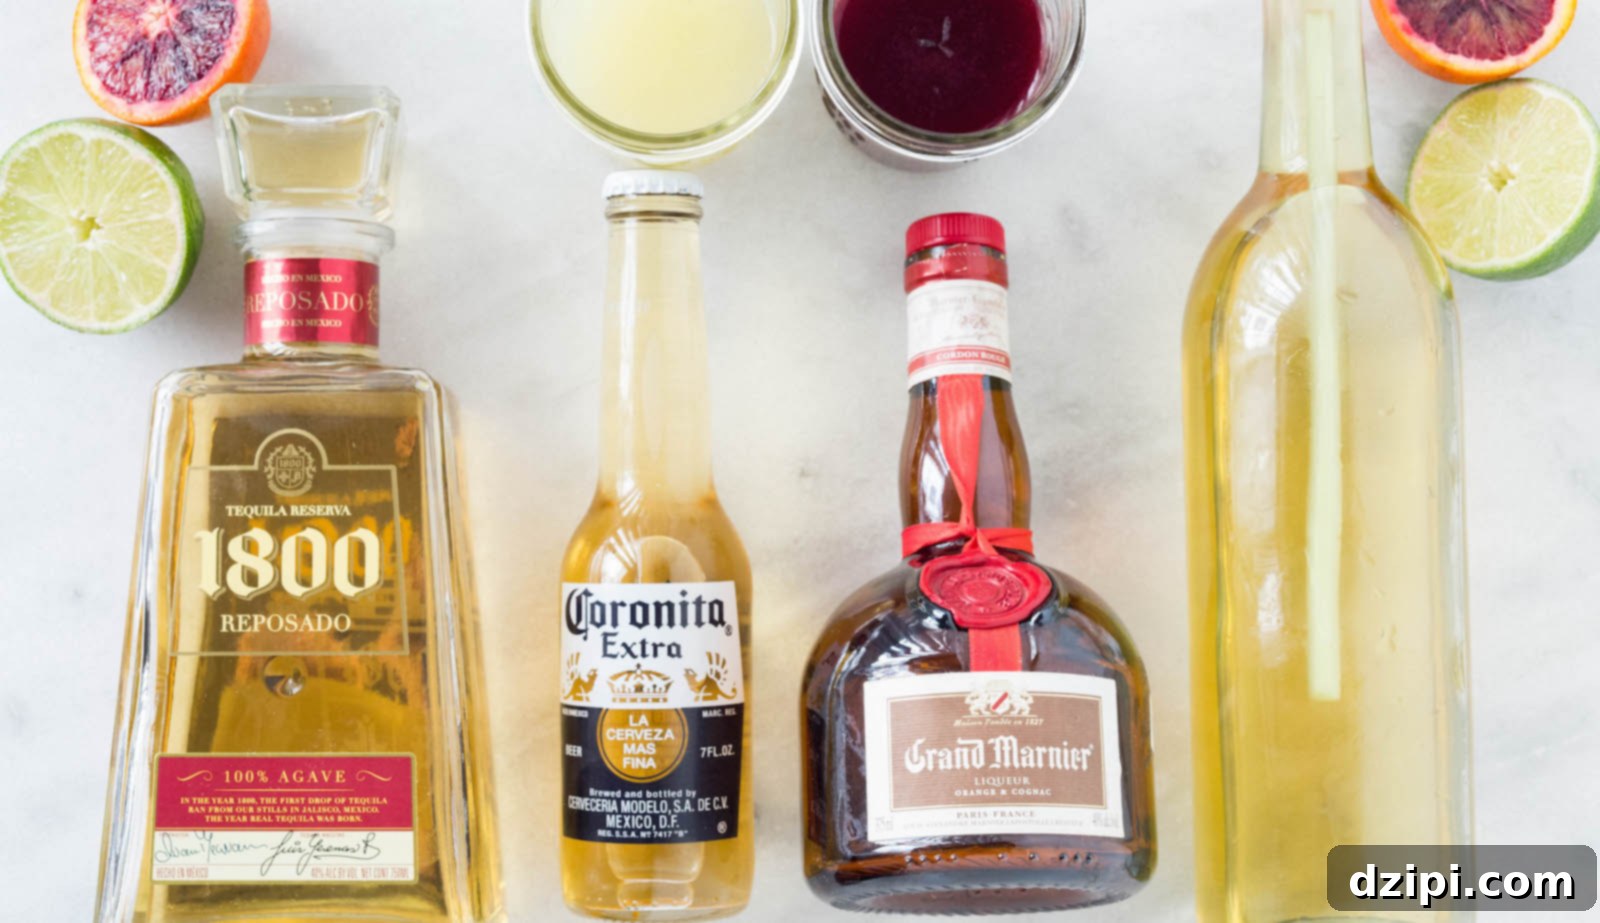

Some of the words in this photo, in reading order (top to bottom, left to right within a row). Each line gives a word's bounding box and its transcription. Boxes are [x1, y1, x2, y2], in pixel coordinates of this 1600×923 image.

[305, 275, 342, 283] MEXICO
[245, 291, 363, 313] REPOSADO
[291, 319, 303, 327] EN
[305, 319, 342, 328] MEXICO
[225, 505, 287, 518] TEQUILA
[290, 505, 352, 516] RESERVA
[194, 527, 385, 601] 1800
[565, 588, 726, 641] Coronita
[220, 613, 351, 633] REPOSADO
[601, 631, 683, 659] Extra
[629, 715, 649, 727] LA
[606, 729, 675, 741] CERVEZA
[565, 744, 583, 757] BEER
[623, 743, 656, 755] MAS
[904, 737, 985, 774] Grand
[988, 735, 1091, 771] Marnier
[623, 757, 656, 769] FINA
[224, 770, 269, 783] 100%
[278, 770, 347, 783] AGAVE
[974, 776, 1031, 787] LIQUEUR
[589, 788, 622, 798] Brewed
[624, 789, 643, 798] and
[645, 788, 683, 798] bottled
[686, 789, 697, 799] by
[954, 789, 996, 797] ORANGE
[1011, 788, 1052, 796] COGNAC
[181, 797, 190, 805] IN
[192, 797, 210, 805] THE
[212, 797, 235, 805] YEAR
[260, 797, 278, 805] THE
[280, 797, 306, 805] FIRST
[308, 797, 333, 805] DROP
[334, 797, 347, 805] OF
[349, 797, 388, 806] TEQUILA
[568, 795, 618, 813] CERVECERIA
[621, 800, 672, 815] MODELO,
[673, 799, 694, 813] S.A.
[697, 798, 711, 812] DE
[713, 796, 728, 810] C.V.
[208, 806, 233, 814] FROM
[235, 806, 254, 814] OUR
[257, 806, 288, 814] STILLS
[290, 806, 300, 814] IN
[956, 811, 988, 819] PARIS
[993, 810, 1035, 818] FRANCE
[205, 815, 222, 823] THE
[224, 815, 247, 823] YEAR
[250, 815, 273, 823] REAL
[275, 815, 314, 824] TEQUILA
[316, 815, 335, 823] WAS
[606, 814, 657, 830] MEXICO,
[659, 815, 680, 829] D.F.
